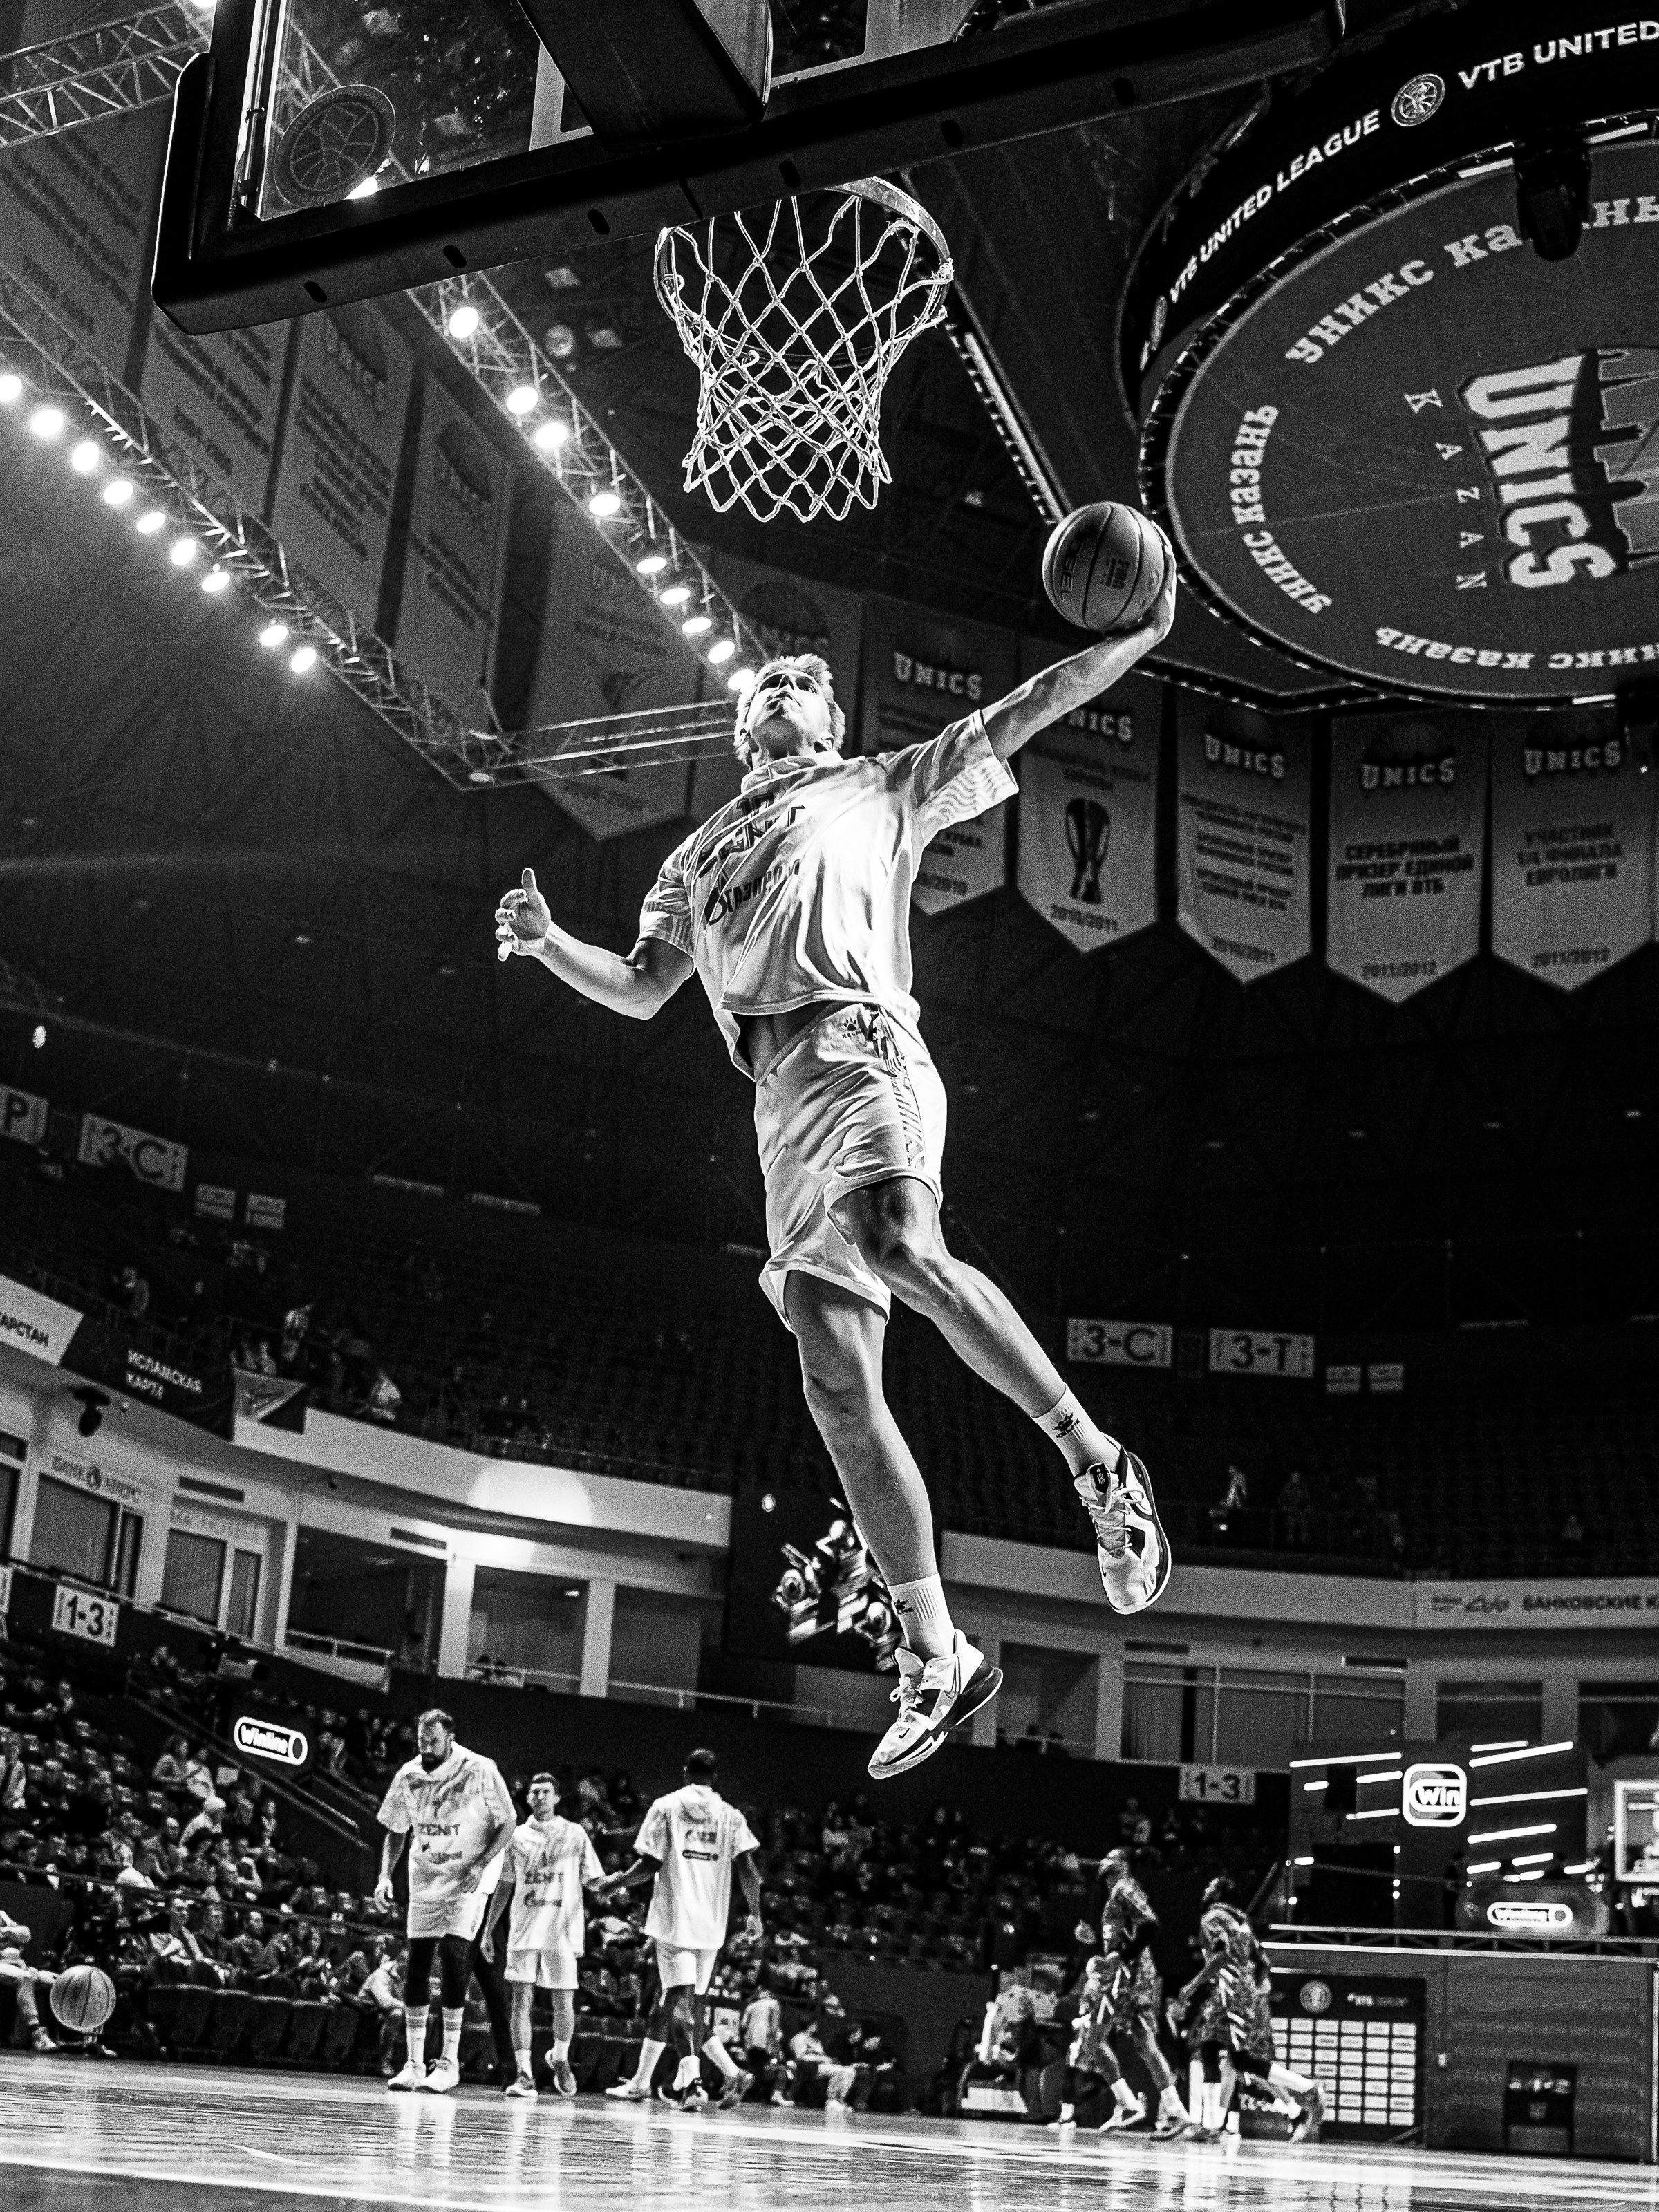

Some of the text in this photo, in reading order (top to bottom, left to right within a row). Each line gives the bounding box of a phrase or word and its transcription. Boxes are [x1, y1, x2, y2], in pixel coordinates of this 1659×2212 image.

[1457, 20, 1659, 90] VTB UNITED
[1170, 109, 1380, 303] VTB UNITED LEAGUE
[1464, 354, 1616, 589] UNICS
[894, 650, 983, 702] UNICS
[1069, 708, 1134, 744] NICS
[1204, 733, 1286, 780] UNICS
[1360, 757, 1456, 790] UNICS
[1523, 740, 1622, 776] UNICS
[1346, 835, 1461, 861] СЕРЕБРЯНЫЙ
[1336, 854, 1474, 881] ПРИЗЕР ЕДИНОЙ
[1361, 879, 1406, 899] ЛИГИ
[0, 1309, 50, 1347] АРСТАН
[125, 1371, 165, 1400] КАРТА
[127, 1348, 203, 1395] ИСЛАМСКАЯ
[67, 1595, 104, 1637] 1-3
[1522, 1595, 1643, 1612] БАНКОВСКИЕ
[1192, 1773, 1241, 1800] 1-3
[418, 1822, 461, 1837] ZENIT
